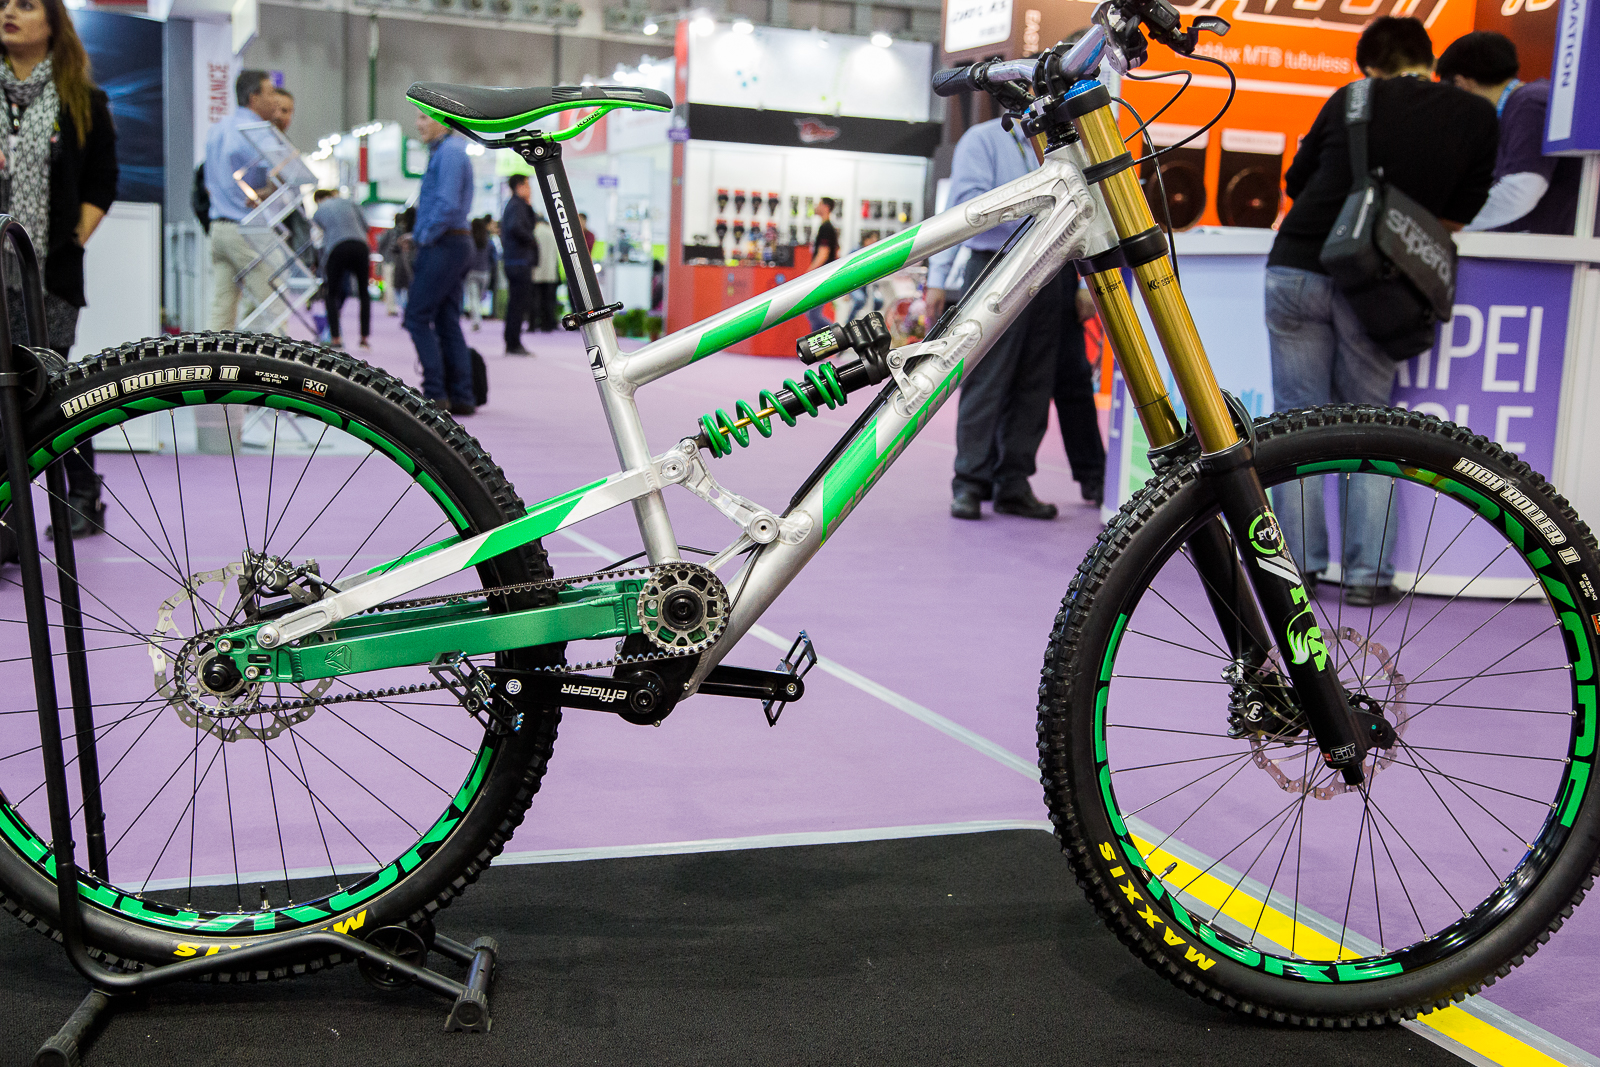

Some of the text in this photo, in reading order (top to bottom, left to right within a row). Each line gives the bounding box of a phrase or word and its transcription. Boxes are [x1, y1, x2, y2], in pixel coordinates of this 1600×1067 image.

[1243, 44, 1284, 67] MTB
[208, 63, 229, 123] FRANCE
[577, 112, 601, 127] KORE
[551, 192, 578, 254] KORE
[61, 365, 240, 418] HIGH ROLLER II
[303, 379, 327, 394] EXO
[1453, 457, 1506, 492] HIGH
[1500, 485, 1566, 545] ROLLER
[1558, 546, 1581, 565] II
[1098, 841, 1217, 971] MAXXIS
[173, 909, 367, 957] MIS
